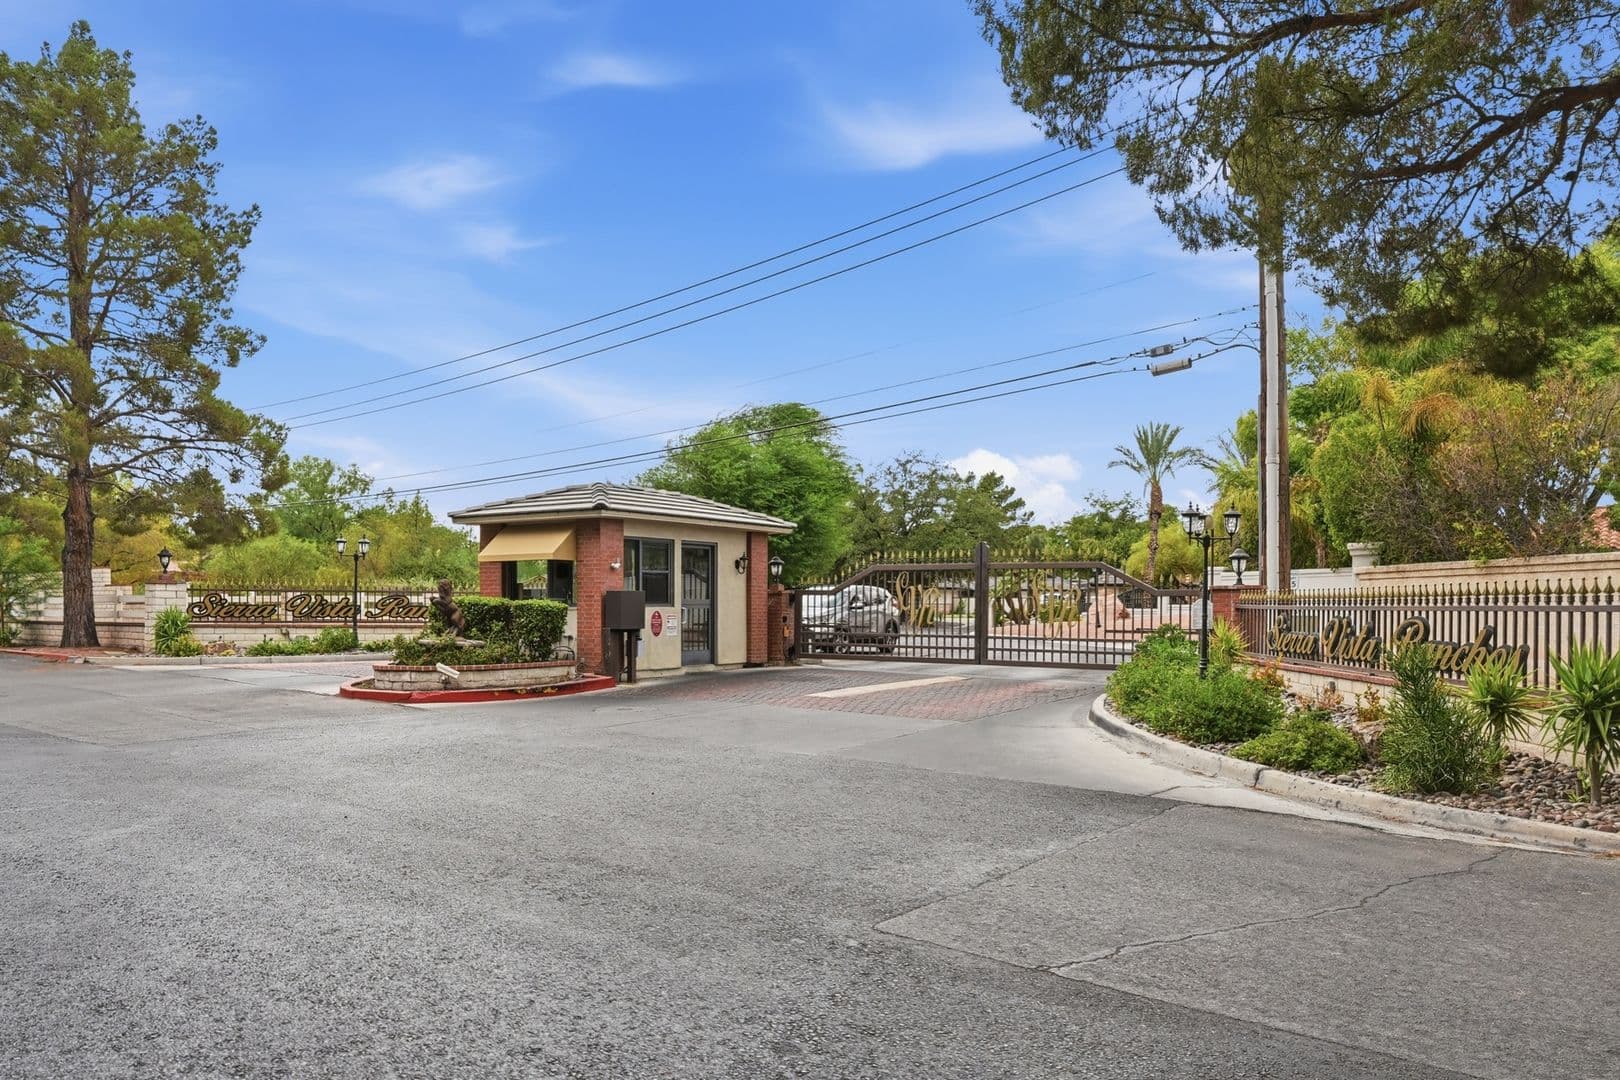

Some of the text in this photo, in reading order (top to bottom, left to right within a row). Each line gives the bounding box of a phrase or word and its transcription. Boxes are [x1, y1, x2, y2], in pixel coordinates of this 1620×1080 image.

[186, 592, 429, 618] Sierra Vista Ran
[1267, 612, 1318, 655] Sierra
[1322, 615, 1381, 662] Vista
